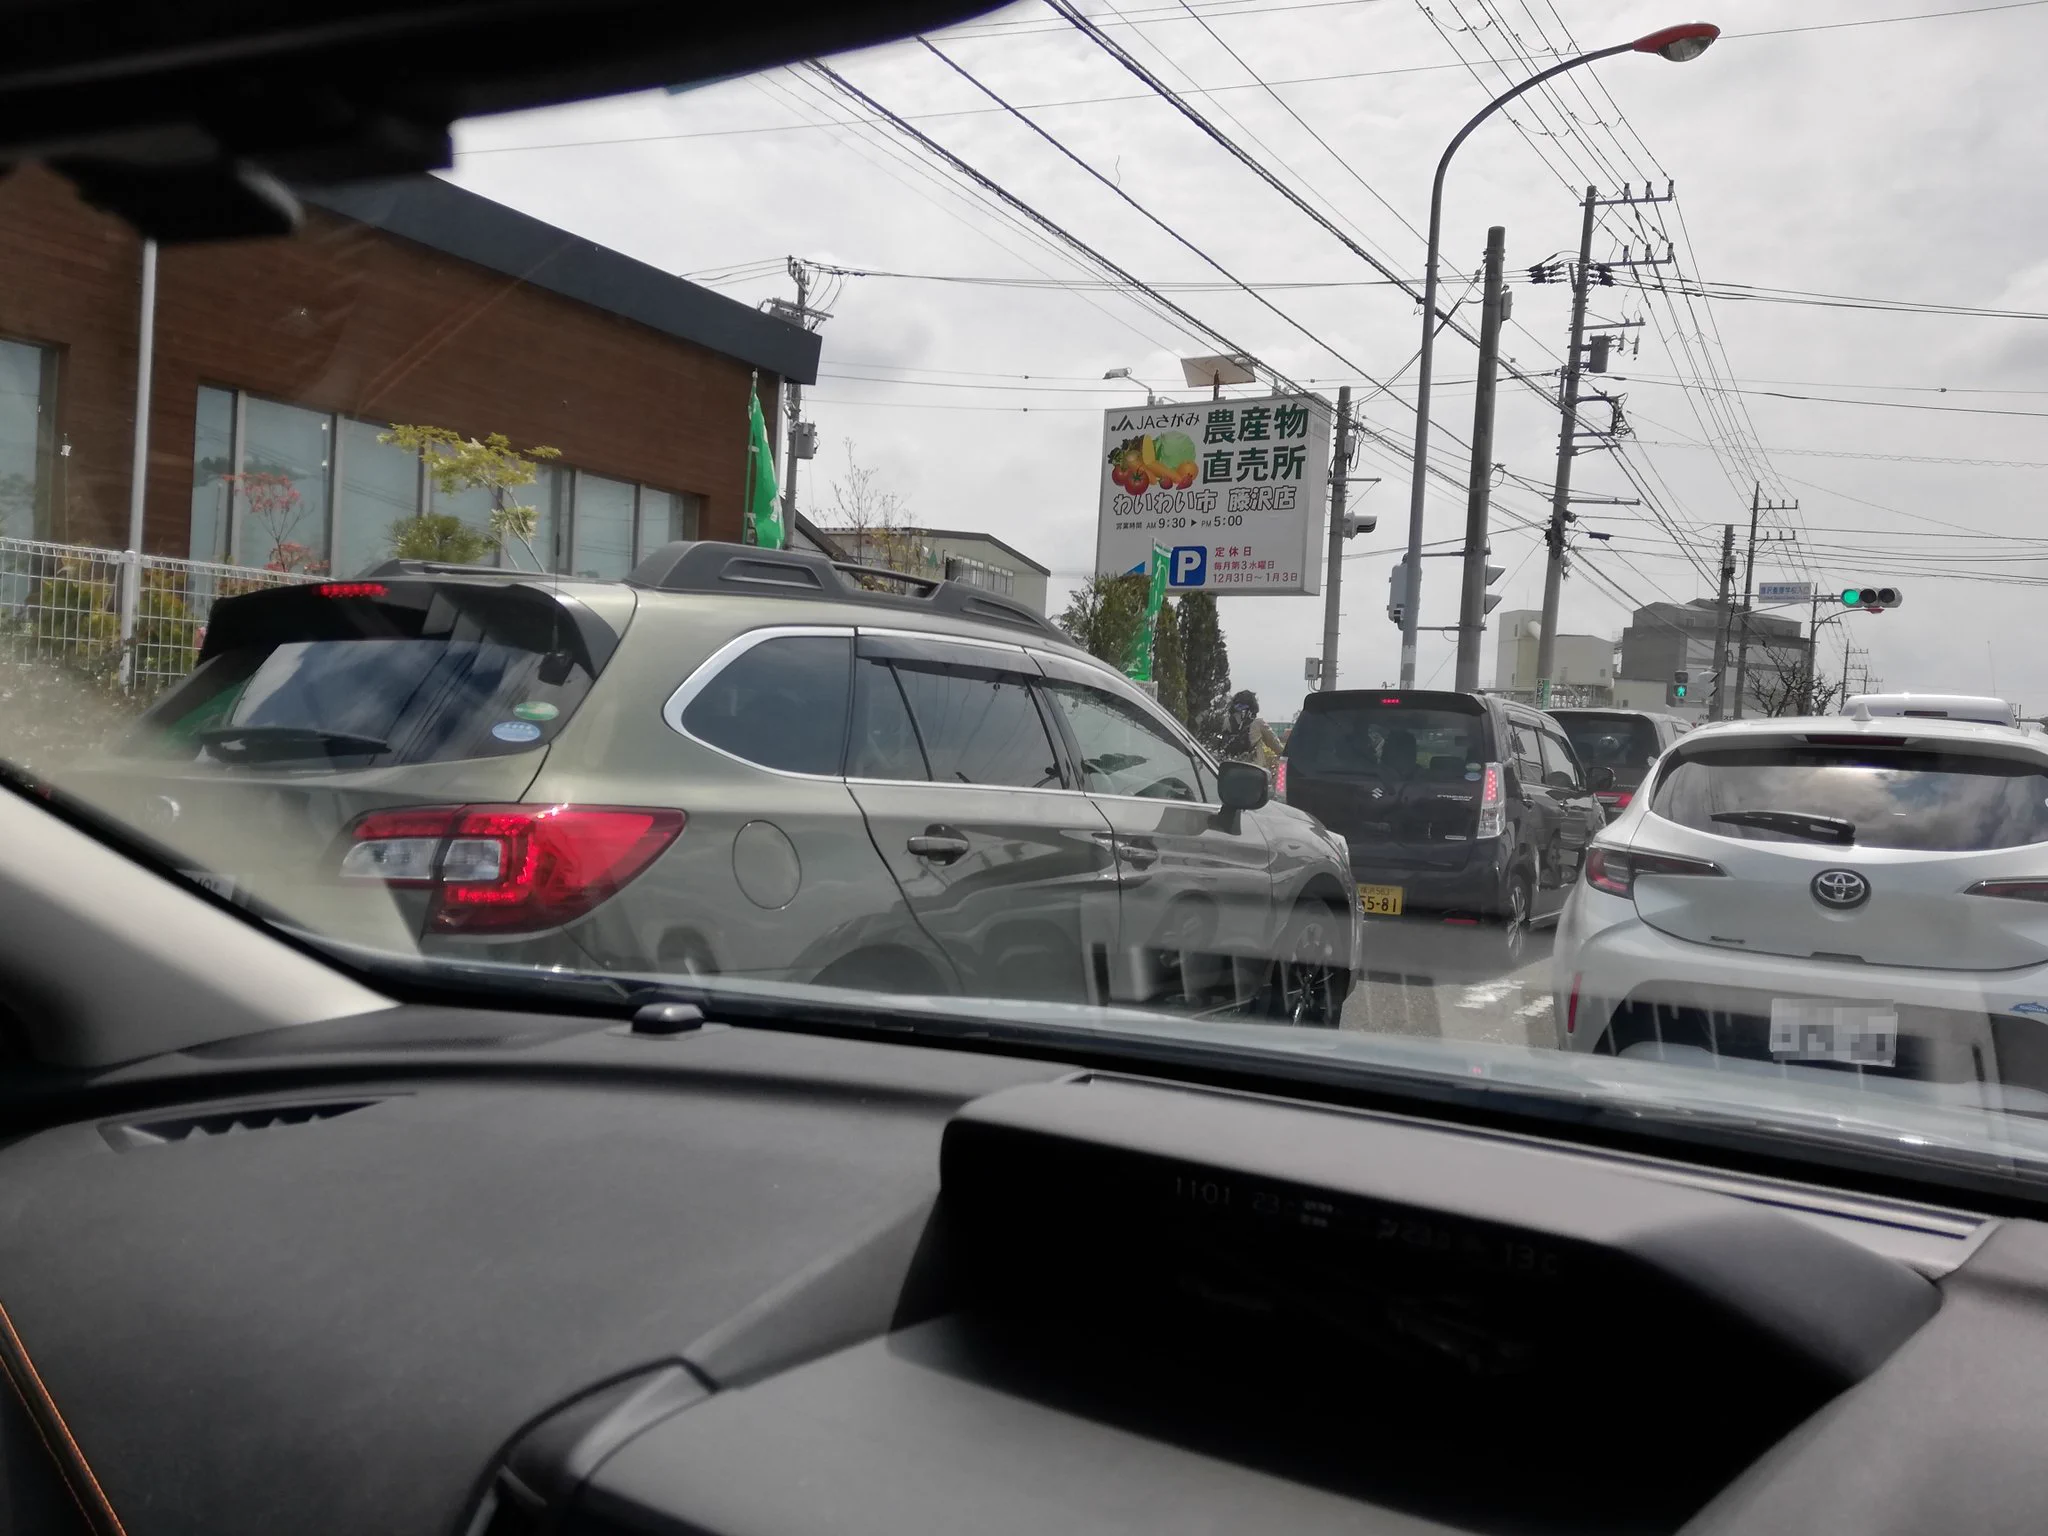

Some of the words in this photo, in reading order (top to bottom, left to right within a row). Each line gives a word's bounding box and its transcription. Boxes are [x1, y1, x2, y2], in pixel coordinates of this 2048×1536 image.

[1136, 412, 1200, 430] JAさがみ
[1202, 403, 1309, 445] 農産物
[1202, 445, 1307, 484] 直売所
[1113, 489, 1218, 515] わいわい市
[1228, 485, 1297, 512] 藤沢店
[1158, 517, 1186, 529] 9:30
[1214, 515, 1243, 527] 5:00
[1214, 546, 1252, 558] 定休日
[1176, 550, 1202, 584] P
[1214, 560, 1275, 571] 毎月第3水曜日
